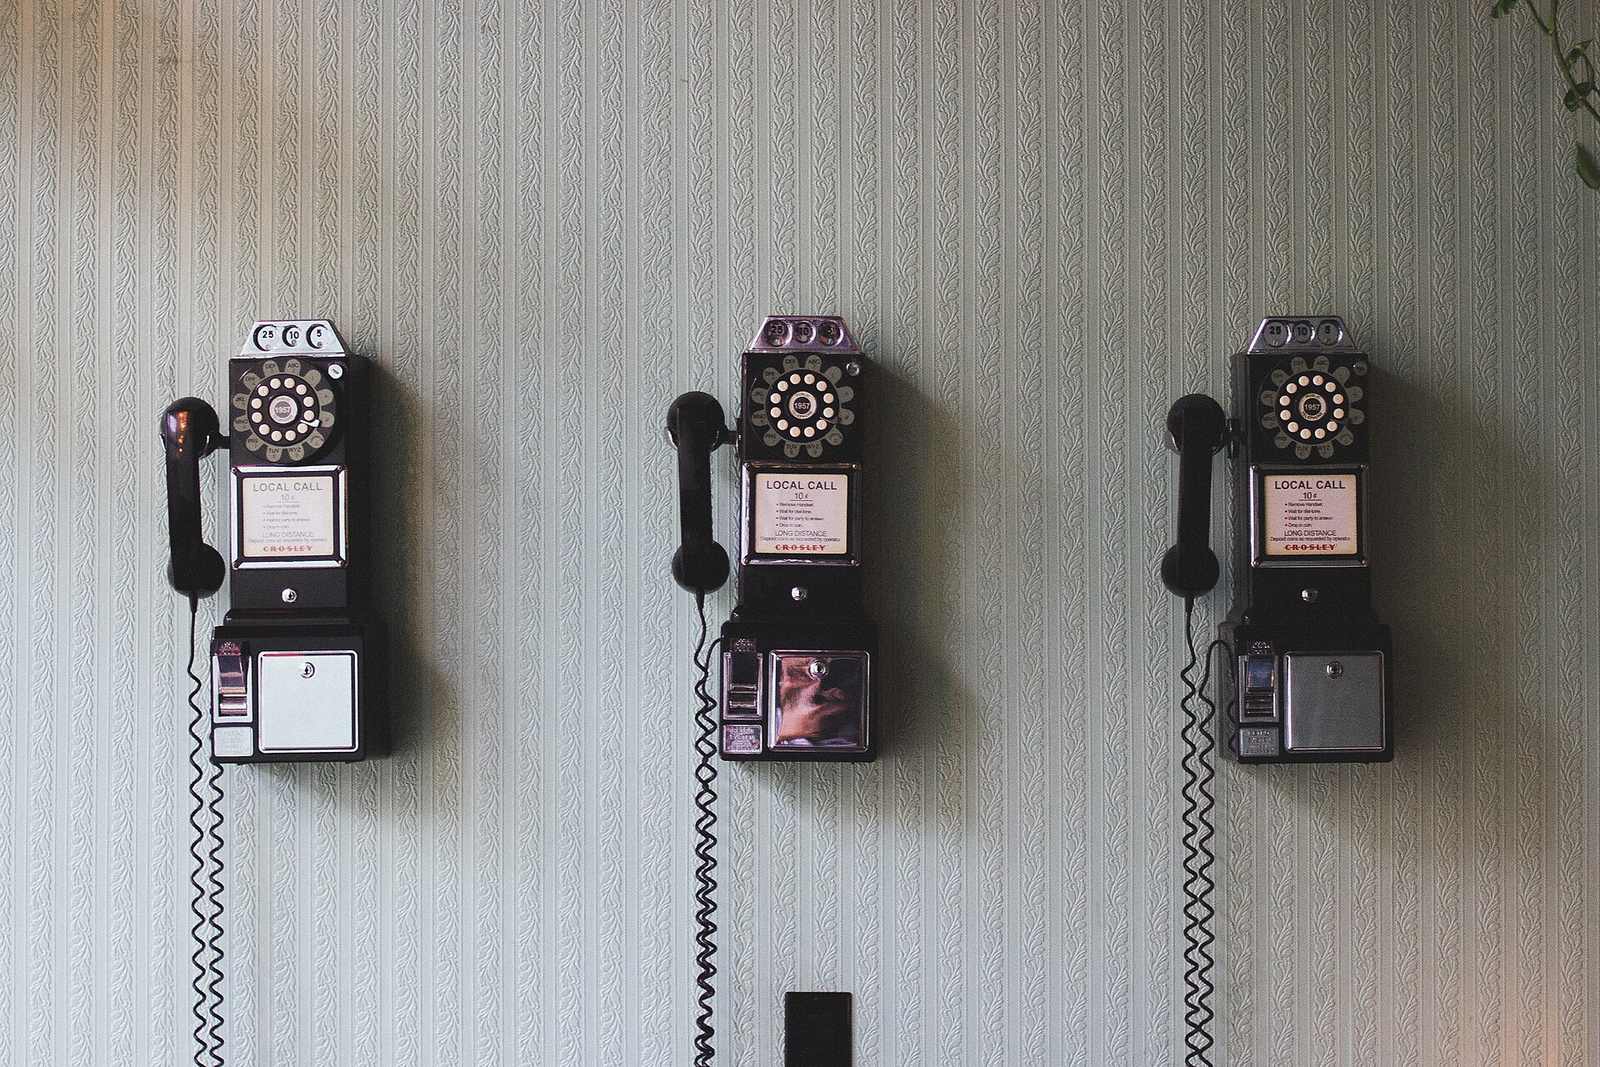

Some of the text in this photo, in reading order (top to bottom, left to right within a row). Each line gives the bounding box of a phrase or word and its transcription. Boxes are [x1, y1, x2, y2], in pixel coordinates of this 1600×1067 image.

[262, 329, 322, 339] 25 10 5
[1297, 327, 1307, 335] 10
[794, 402, 810, 410] 1957
[1305, 403, 1320, 411] 1957
[252, 481, 323, 492] LOCAL CALL
[766, 480, 837, 491] LOCAL CALL
[1274, 480, 1346, 490] LOCAL CALL
[1285, 543, 1336, 551] CROSLEY
